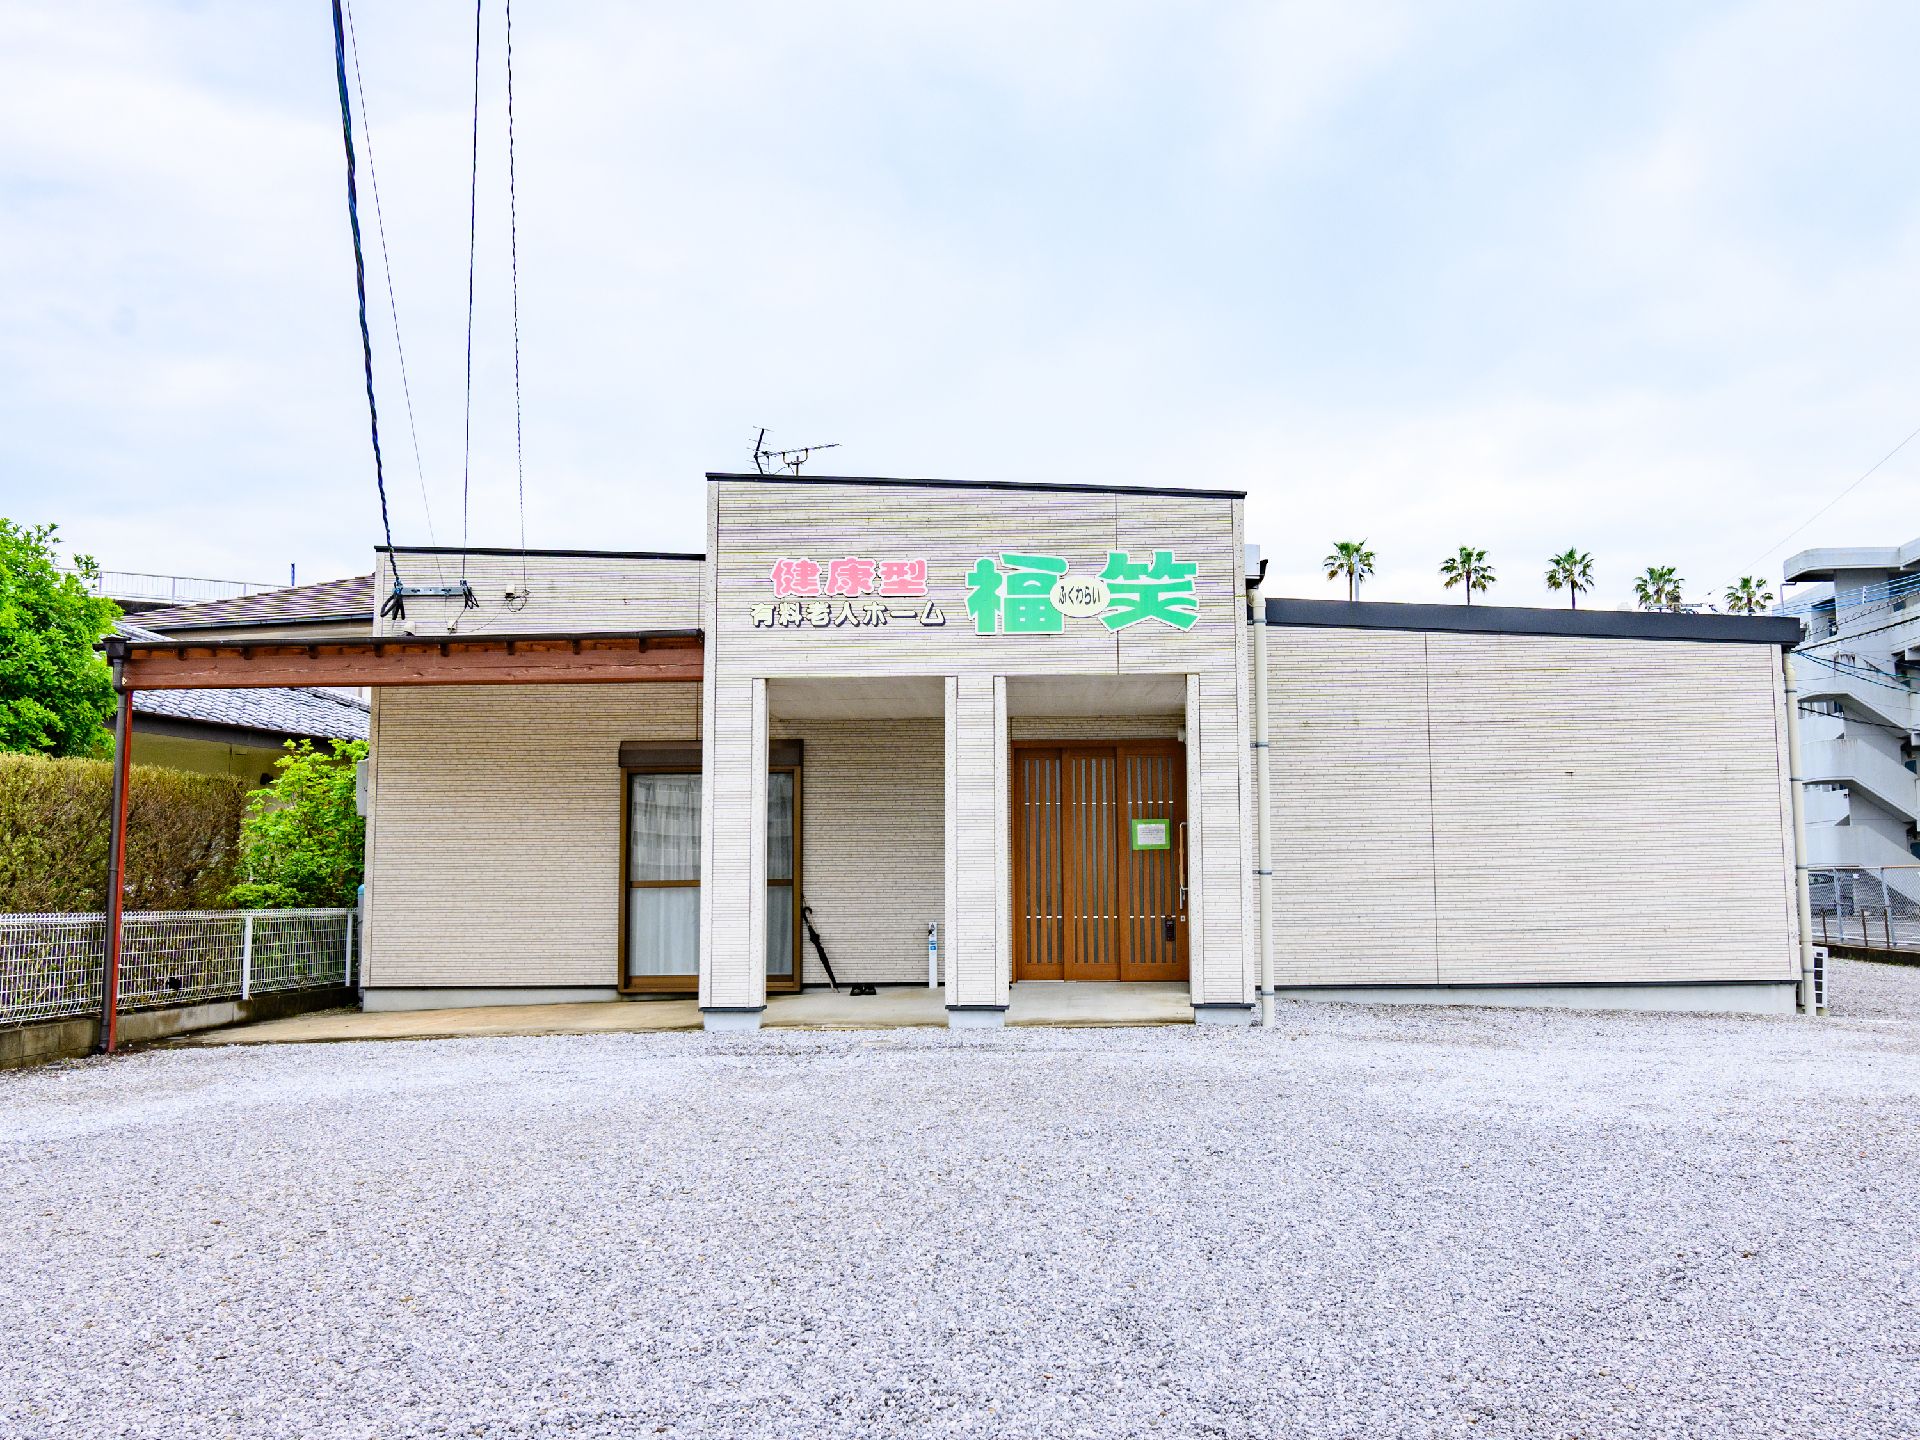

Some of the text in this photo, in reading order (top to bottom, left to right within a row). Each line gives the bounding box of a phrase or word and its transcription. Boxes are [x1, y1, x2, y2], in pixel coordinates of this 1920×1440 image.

[771, 557, 929, 597] 健康型
[966, 551, 1199, 635] 福笑
[1058, 585, 1101, 606] ふくわらい
[751, 602, 945, 628] 有料老人ホーム
